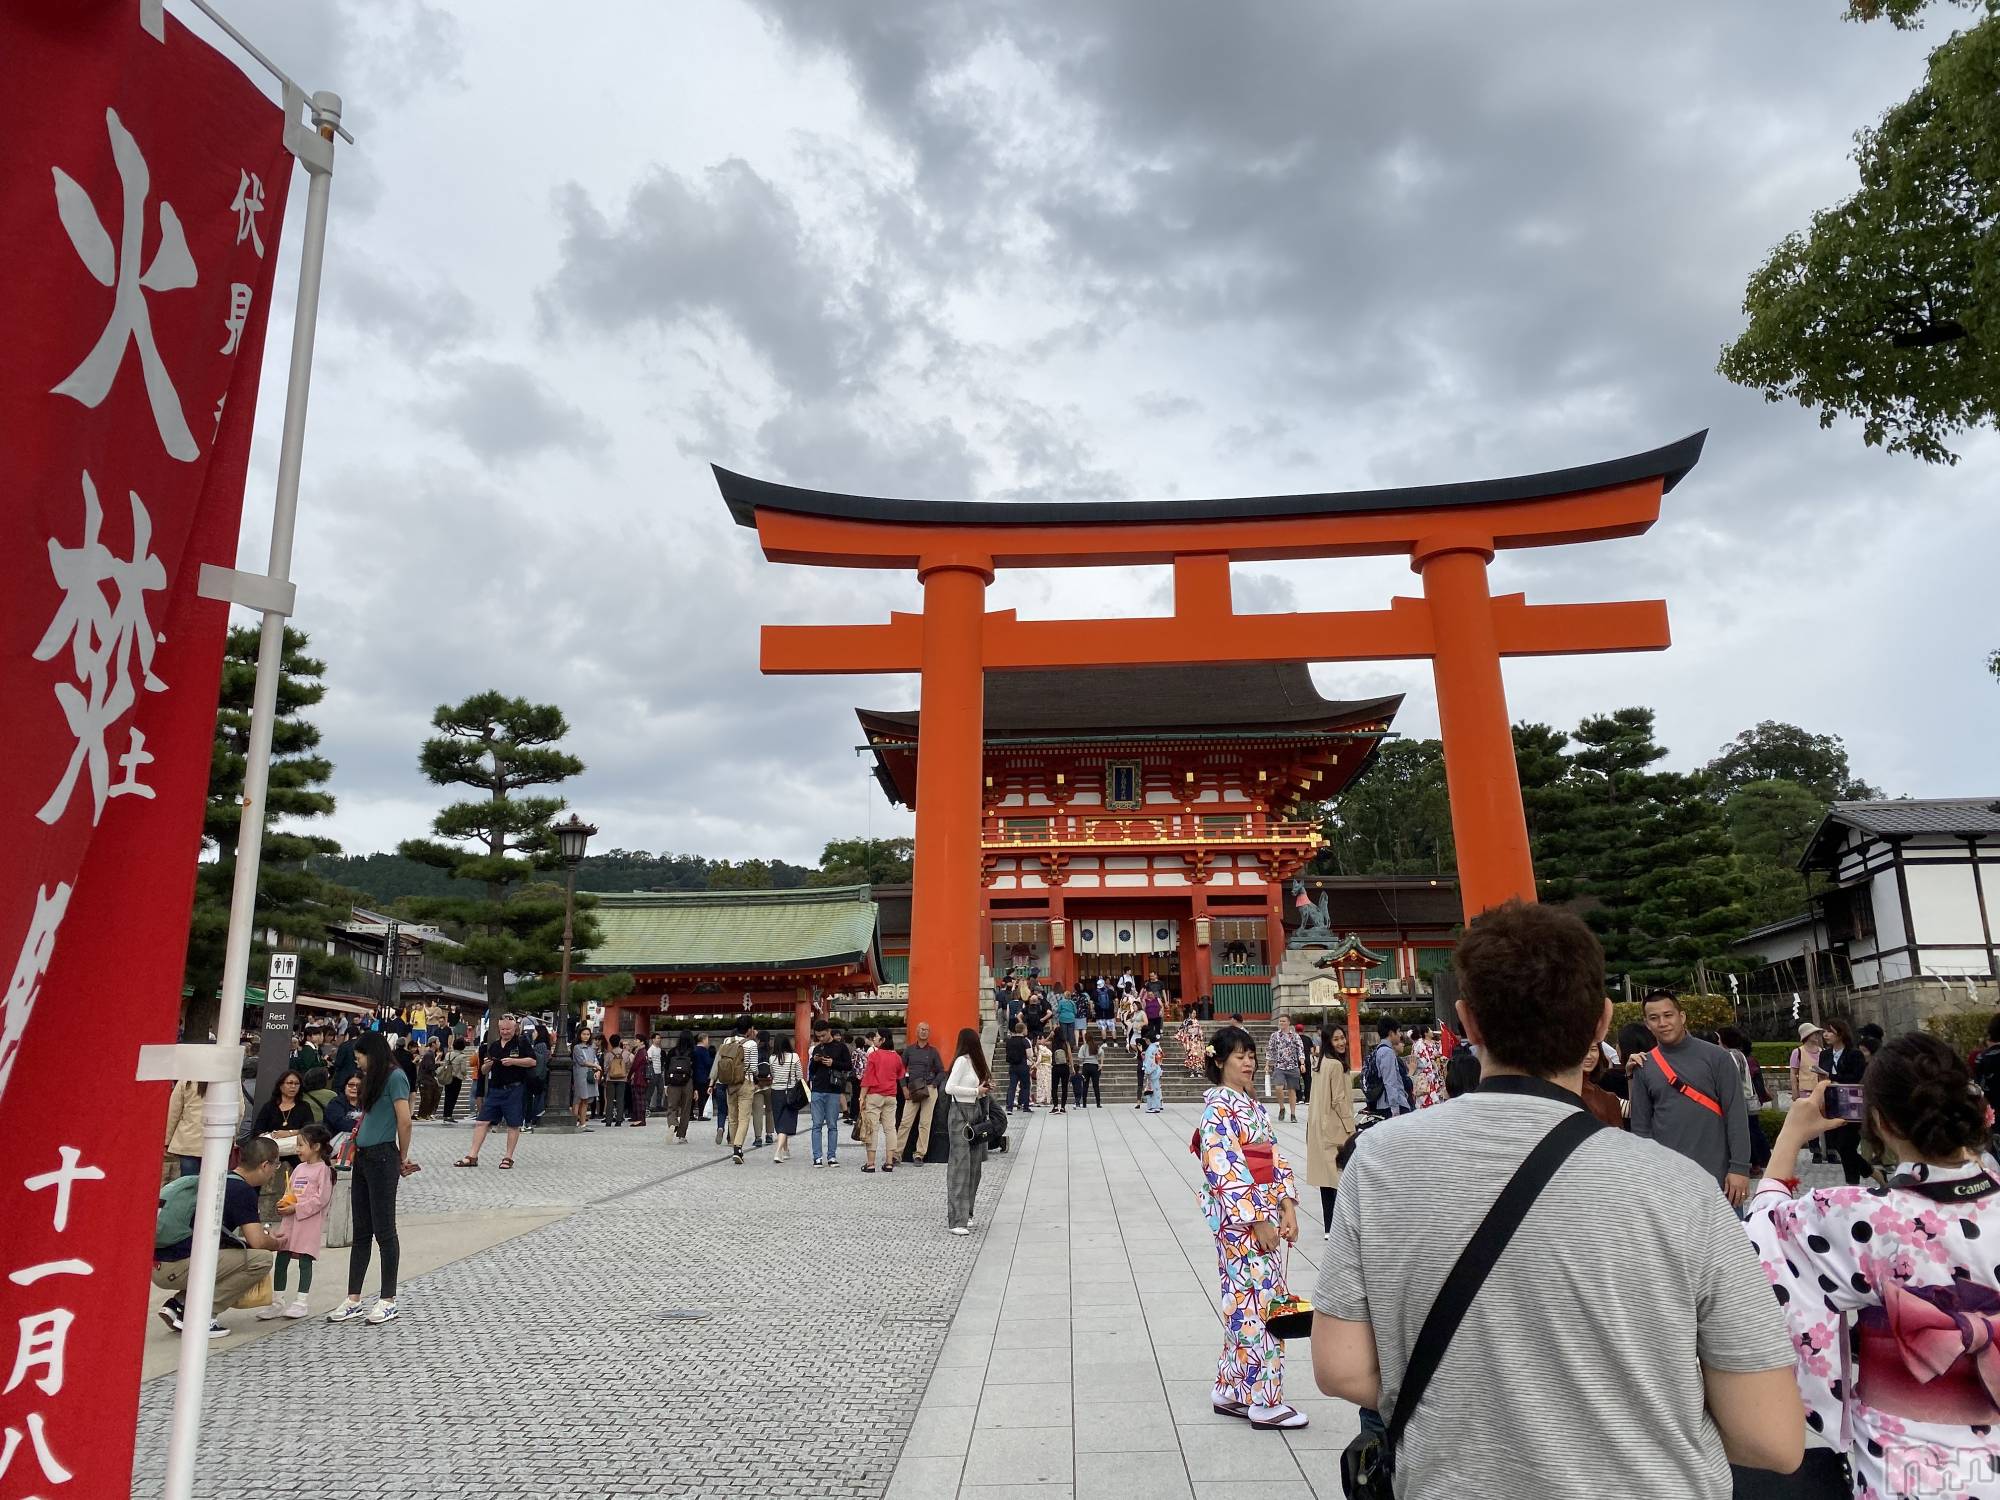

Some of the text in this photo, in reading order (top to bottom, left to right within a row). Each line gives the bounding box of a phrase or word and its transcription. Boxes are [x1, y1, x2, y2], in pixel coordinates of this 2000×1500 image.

[268, 1012, 286, 1021] Rest
[265, 1021, 289, 1030] Room
[1953, 1179, 1992, 1197] Canon
